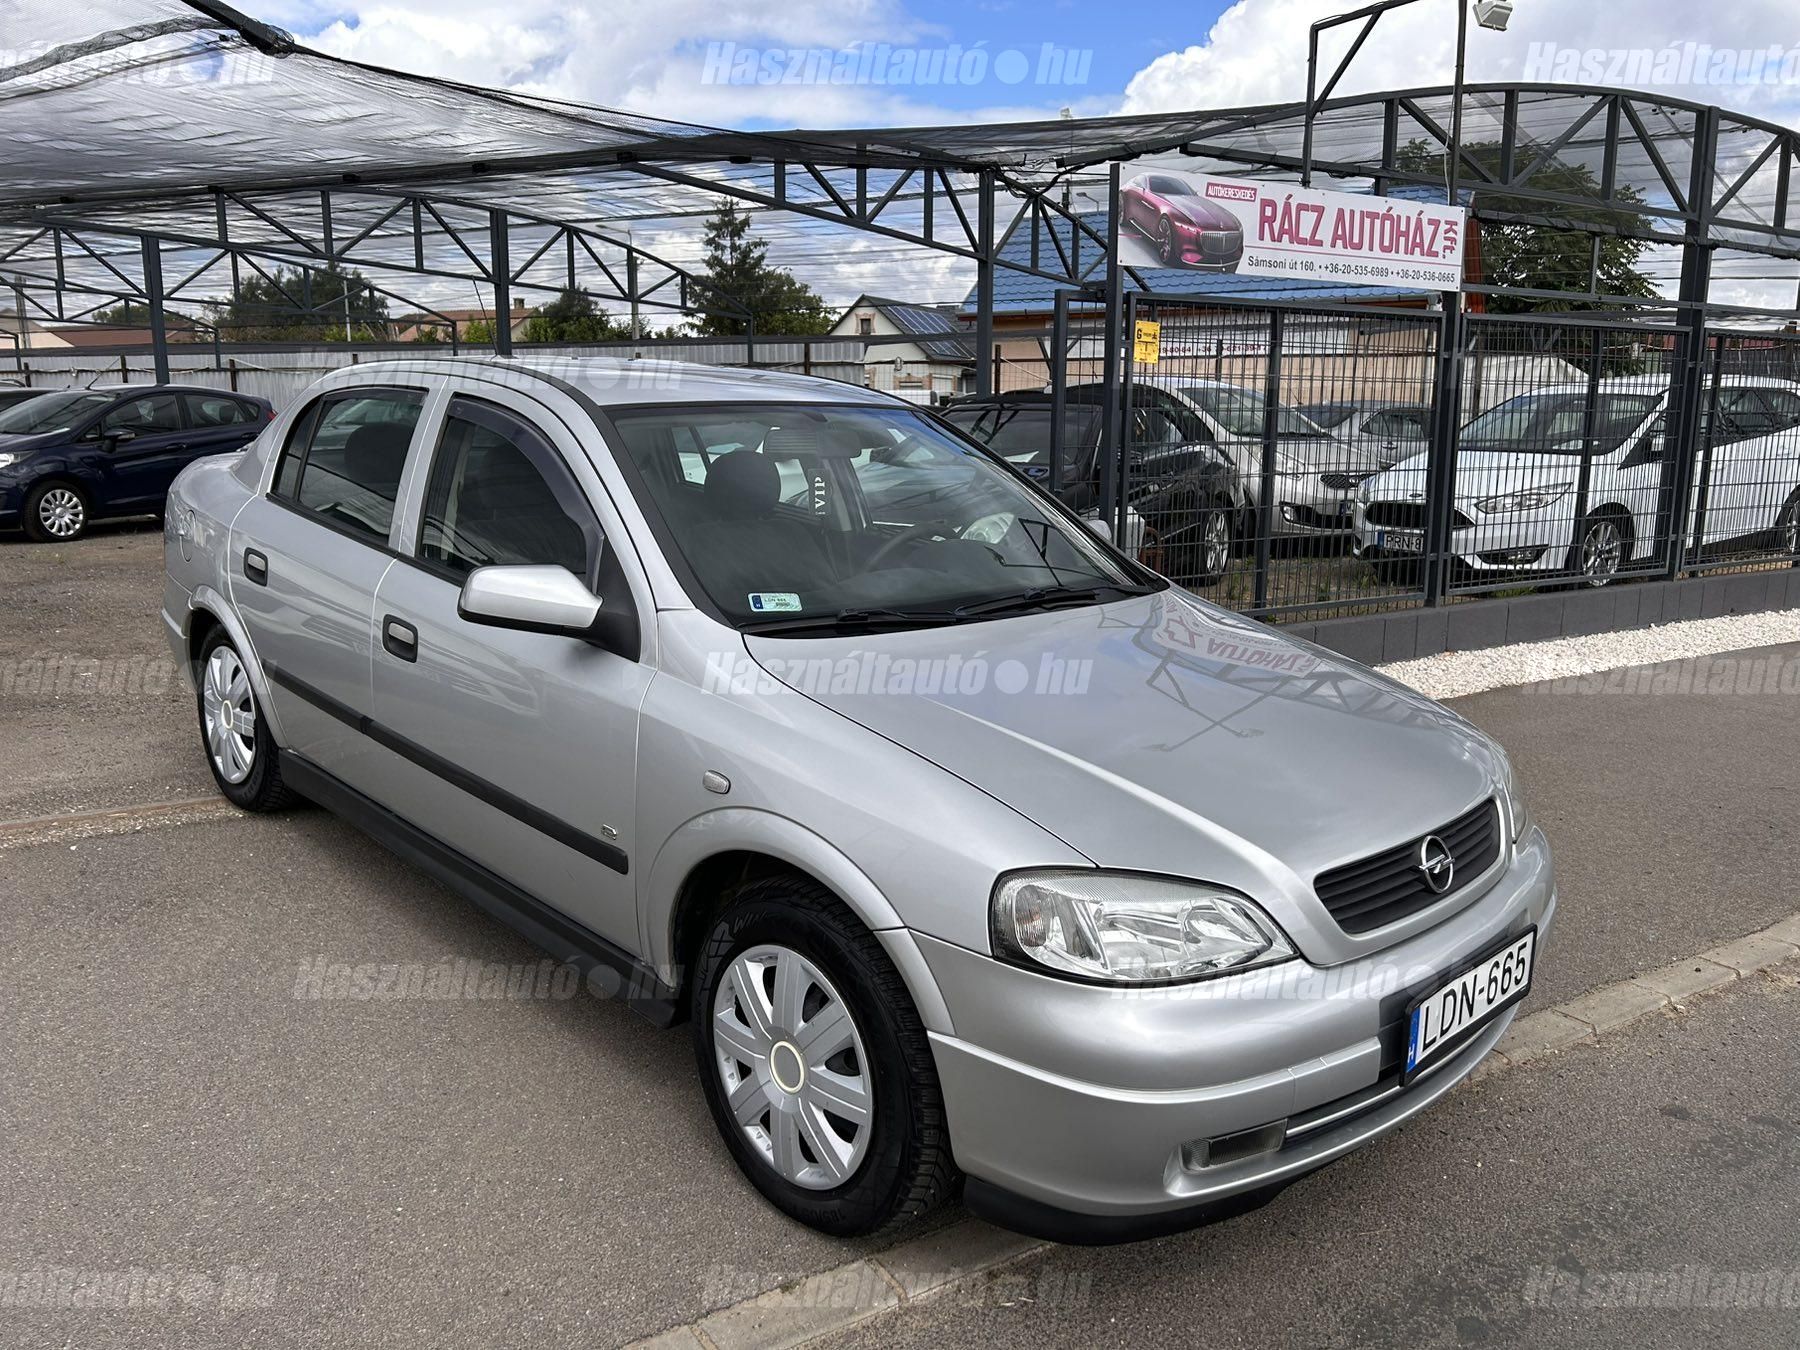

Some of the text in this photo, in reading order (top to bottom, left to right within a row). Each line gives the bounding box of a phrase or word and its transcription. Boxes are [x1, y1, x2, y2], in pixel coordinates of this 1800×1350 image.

[1207, 184, 1255, 201] AUTÓKERESKEDÉS
[1258, 194, 1325, 247] RÁCZ
[1330, 206, 1441, 258] AUTÓHÁZ
[1248, 255, 1455, 283] Sámsoni út 160. +36-20-535-6989 +36-20-536-0665
[814, 476, 826, 509] VIP
[1422, 941, 1528, 1052] LDN-665
